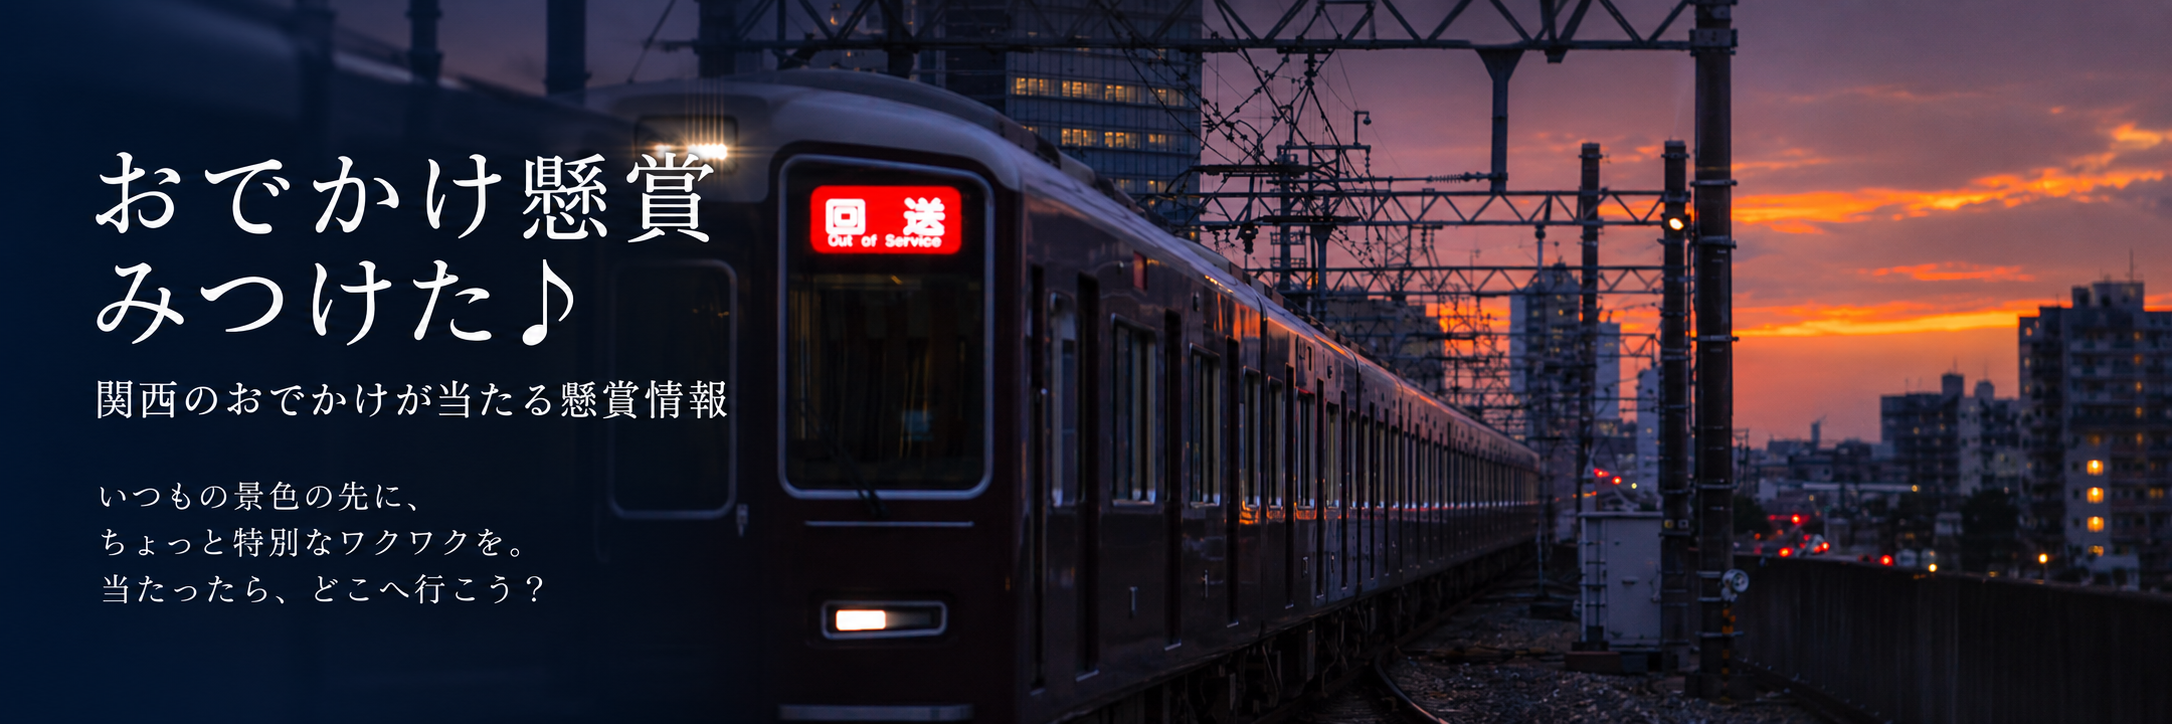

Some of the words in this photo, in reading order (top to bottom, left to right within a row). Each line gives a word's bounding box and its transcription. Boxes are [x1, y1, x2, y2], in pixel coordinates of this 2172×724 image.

[825, 197, 946, 236] 回送
[827, 233, 853, 248] Out
[861, 234, 878, 248] of
[885, 233, 943, 248] Service
